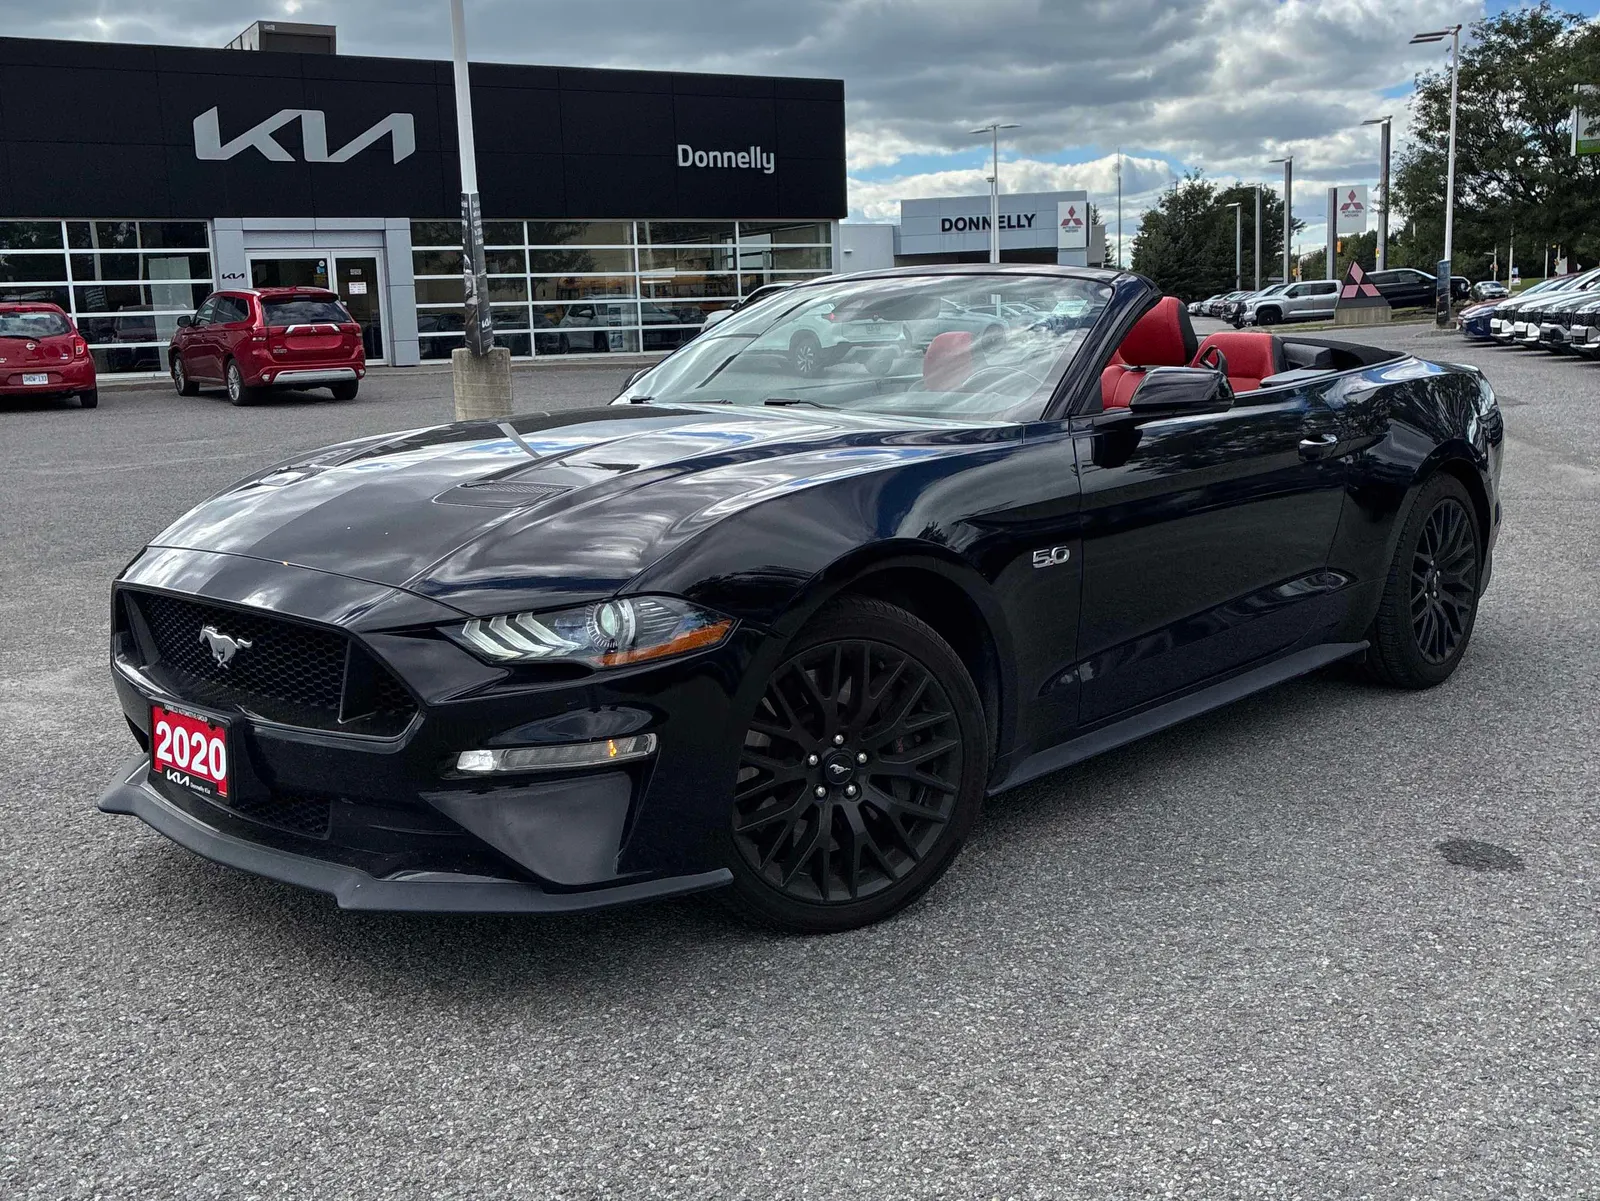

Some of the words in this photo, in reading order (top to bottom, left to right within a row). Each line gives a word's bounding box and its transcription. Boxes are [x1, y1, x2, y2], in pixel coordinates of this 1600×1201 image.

[193, 105, 416, 165] KIA
[677, 144, 775, 174] Donnelly
[941, 213, 1036, 232] DONNELLY
[1033, 545, 1070, 568] 5.0
[156, 720, 226, 780] 2020
[166, 769, 190, 786] KIA
